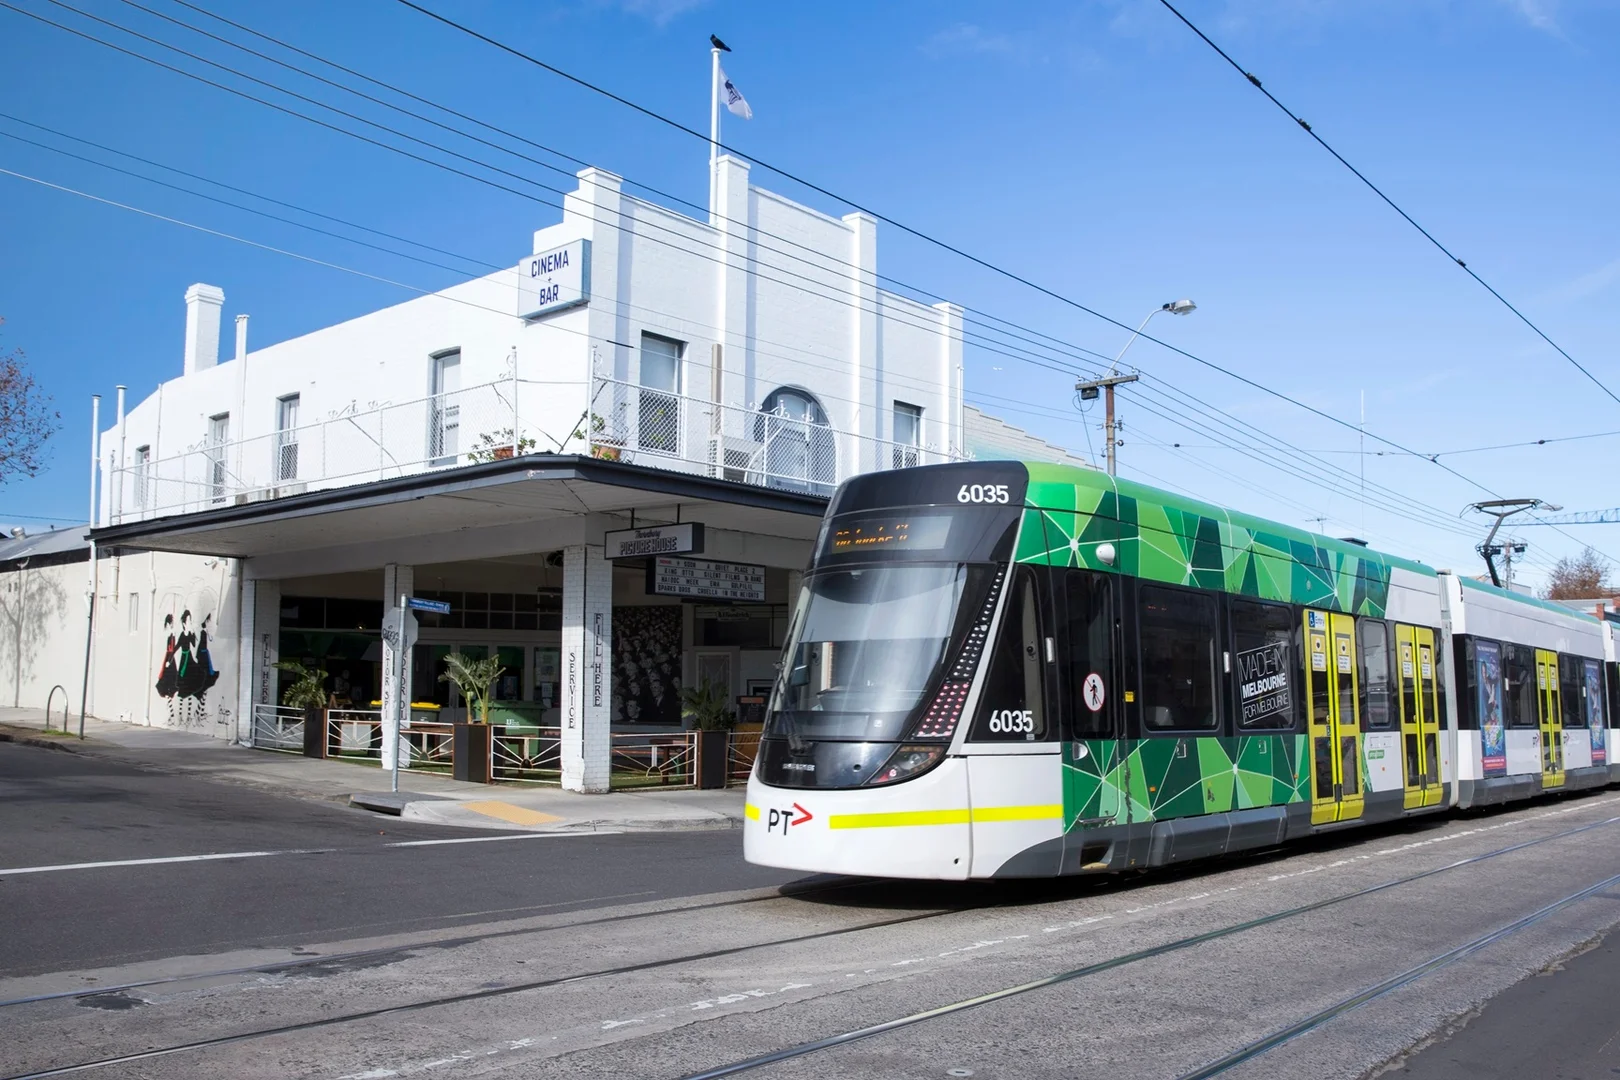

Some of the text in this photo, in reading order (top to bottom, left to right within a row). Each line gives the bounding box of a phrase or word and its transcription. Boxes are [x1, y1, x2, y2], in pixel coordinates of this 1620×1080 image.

[531, 250, 569, 278] CINEMA
[540, 284, 559, 305] BAR
[957, 484, 1010, 504] 6035
[686, 578, 699, 586] WEEK
[734, 566, 748, 574] PLACE
[658, 584, 677, 592] SPARKS
[740, 591, 759, 599] HEIGHTS
[595, 613, 603, 707] FILL HERE
[1239, 649, 1273, 682] MADE
[568, 652, 577, 729] SERVICE
[1242, 673, 1287, 699] MELBOURNE
[1244, 693, 1289, 720] FOR MELBOURNE
[989, 710, 1034, 732] 6035
